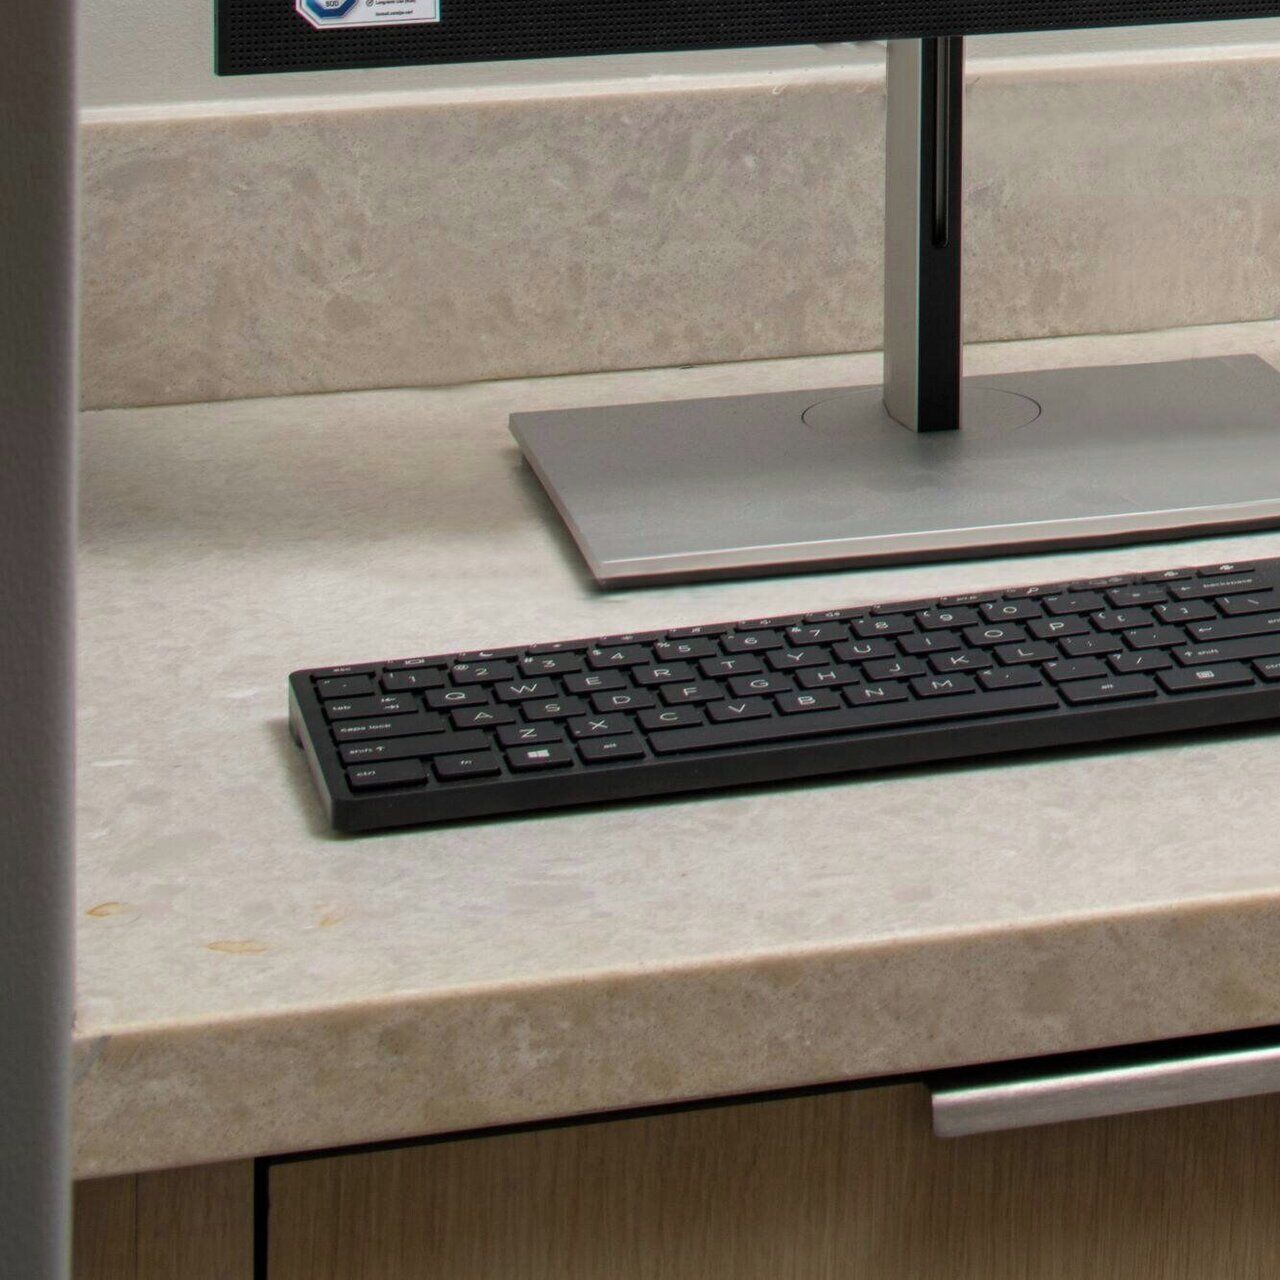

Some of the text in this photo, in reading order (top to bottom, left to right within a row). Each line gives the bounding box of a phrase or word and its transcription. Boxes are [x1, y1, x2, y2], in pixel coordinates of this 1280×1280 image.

[1049, 622, 1065, 631] P
[809, 629, 821, 637] 7
[984, 629, 1004, 638] O
[678, 644, 691, 653] 5
[853, 644, 872, 654] U
[1017, 648, 1034, 657] L
[786, 652, 804, 661] Y
[950, 655, 970, 665] K
[542, 660, 556, 668] 3
[720, 660, 736, 669] T
[889, 663, 901, 672] J
[476, 668, 488, 676] 2
[653, 669, 672, 678] R
[817, 671, 837, 681] H
[585, 677, 602, 686] E
[750, 679, 769, 689] G
[931, 679, 953, 689] M
[510, 683, 538, 694] W
[683, 687, 697, 697] F
[864, 688, 885, 698] N
[612, 695, 631, 705] D
[797, 696, 816, 705] B
[727, 703, 746, 713] V
[474, 711, 494, 721] A
[659, 712, 679, 721] C
[588, 720, 608, 730] X
[519, 728, 537, 738] Z
